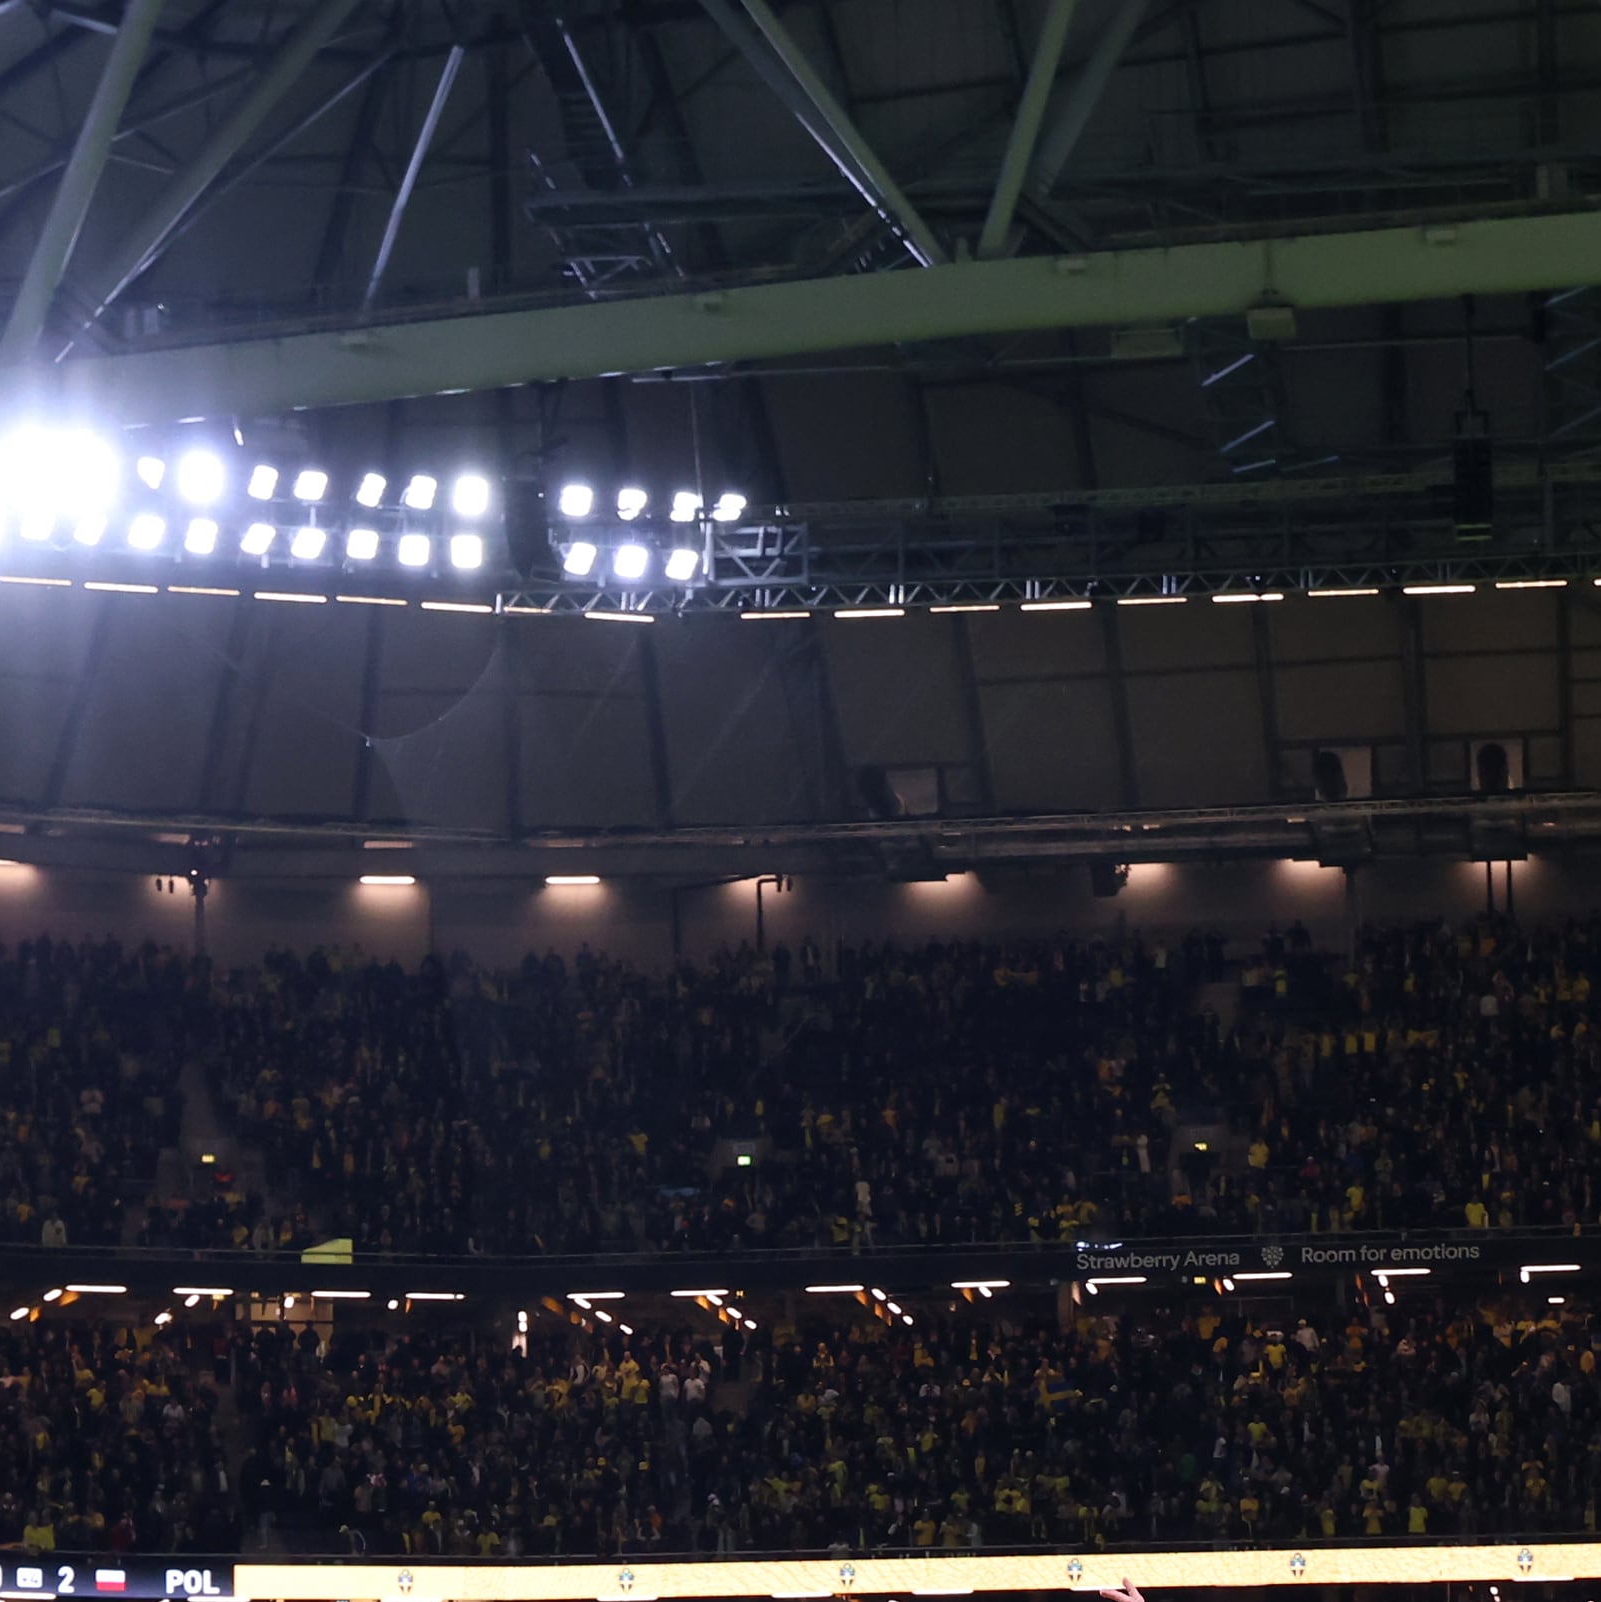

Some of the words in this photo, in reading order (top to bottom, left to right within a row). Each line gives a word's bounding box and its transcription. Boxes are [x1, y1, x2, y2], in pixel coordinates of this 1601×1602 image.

[1076, 1253, 1180, 1270] Strawberry
[1184, 1250, 1240, 1267] Arena
[1302, 1246, 1356, 1264] Room
[1361, 1244, 1388, 1261] for
[1392, 1243, 1480, 1262] emotions
[57, 1566, 75, 1594] 2
[165, 1569, 220, 1595] POL
